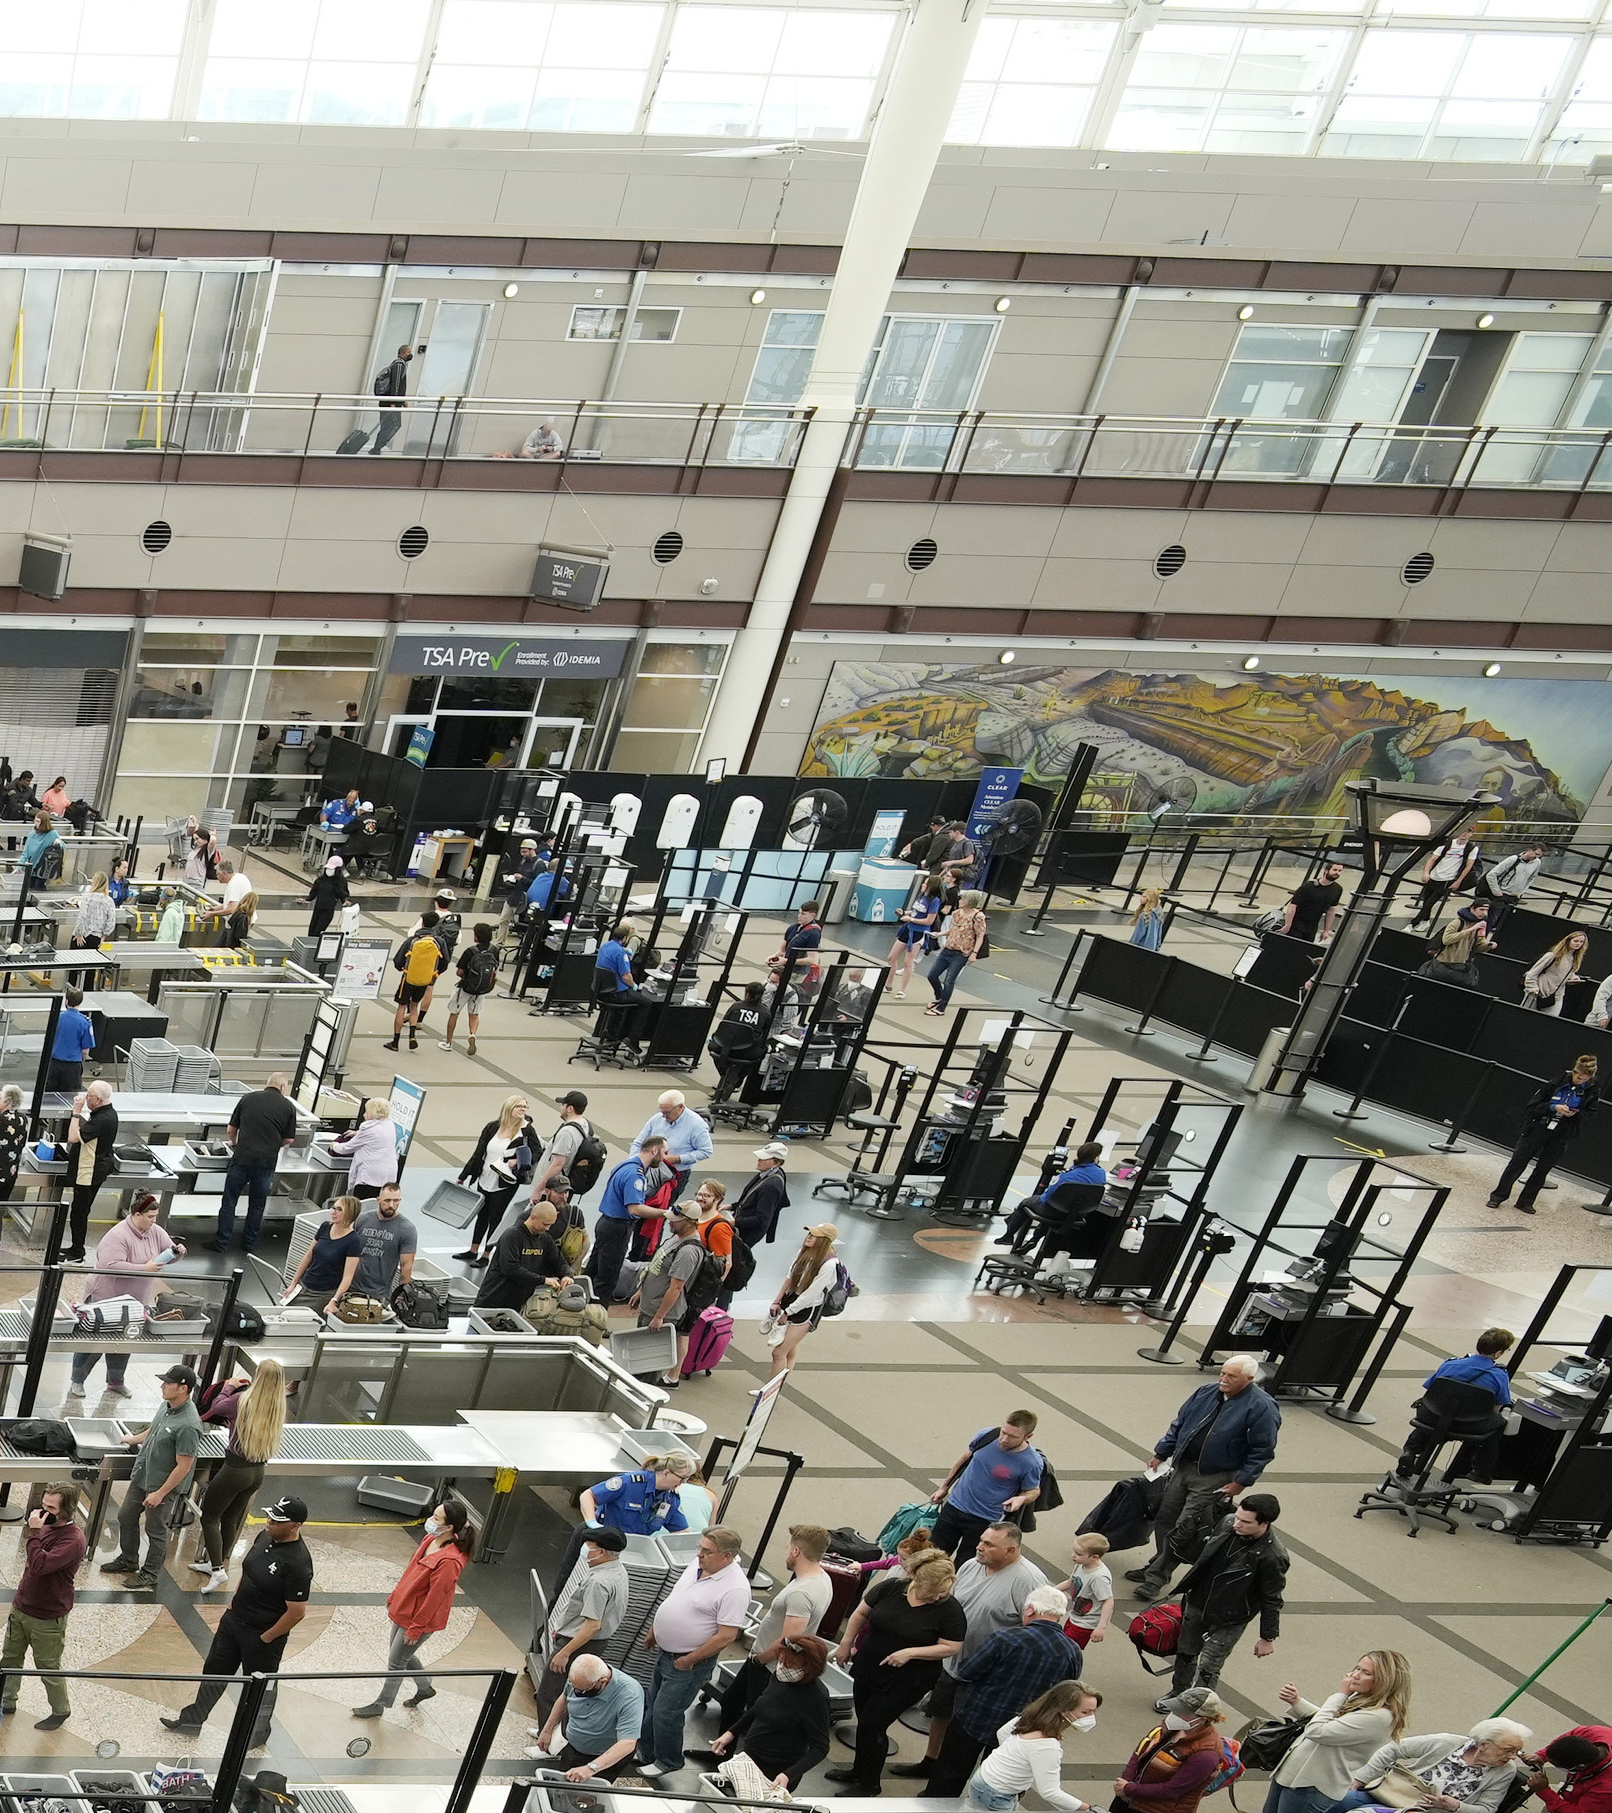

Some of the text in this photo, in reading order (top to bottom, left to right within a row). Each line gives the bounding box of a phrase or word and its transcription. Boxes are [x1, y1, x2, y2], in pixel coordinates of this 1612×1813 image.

[422, 647, 490, 666] TSA Pre
[515, 658, 540, 666] Provided
[516, 651, 547, 659] Enrollment
[569, 655, 611, 664] IDEMIA
[739, 1008, 760, 1025] TSA
[392, 1100, 416, 1118] HOLD IT
[361, 1227, 395, 1242] REDEMPTION
[365, 1237, 384, 1247] SQUAD
[161, 1774, 190, 1788] BATH
